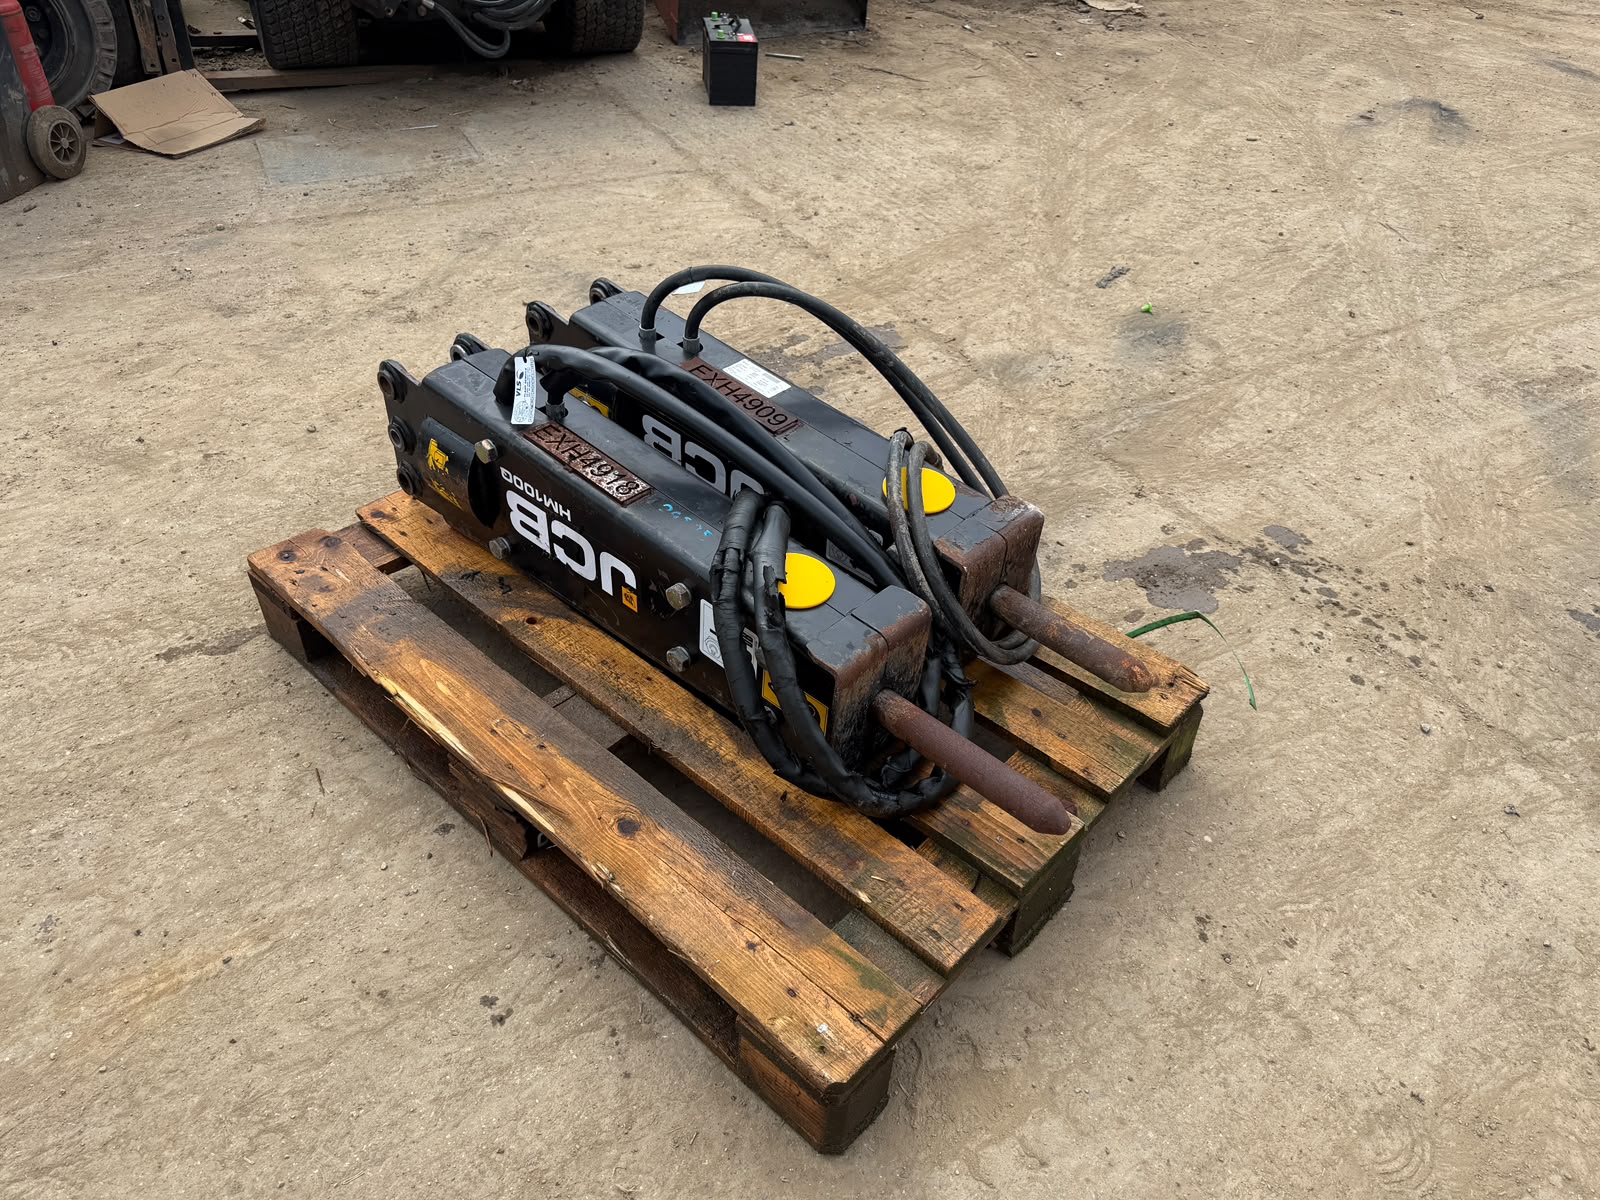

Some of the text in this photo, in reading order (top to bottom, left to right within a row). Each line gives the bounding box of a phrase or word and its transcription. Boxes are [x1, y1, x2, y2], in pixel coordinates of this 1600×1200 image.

[688, 363, 788, 427] EXH4909
[533, 424, 640, 496] EXH4918
[506, 489, 637, 597] JCB
